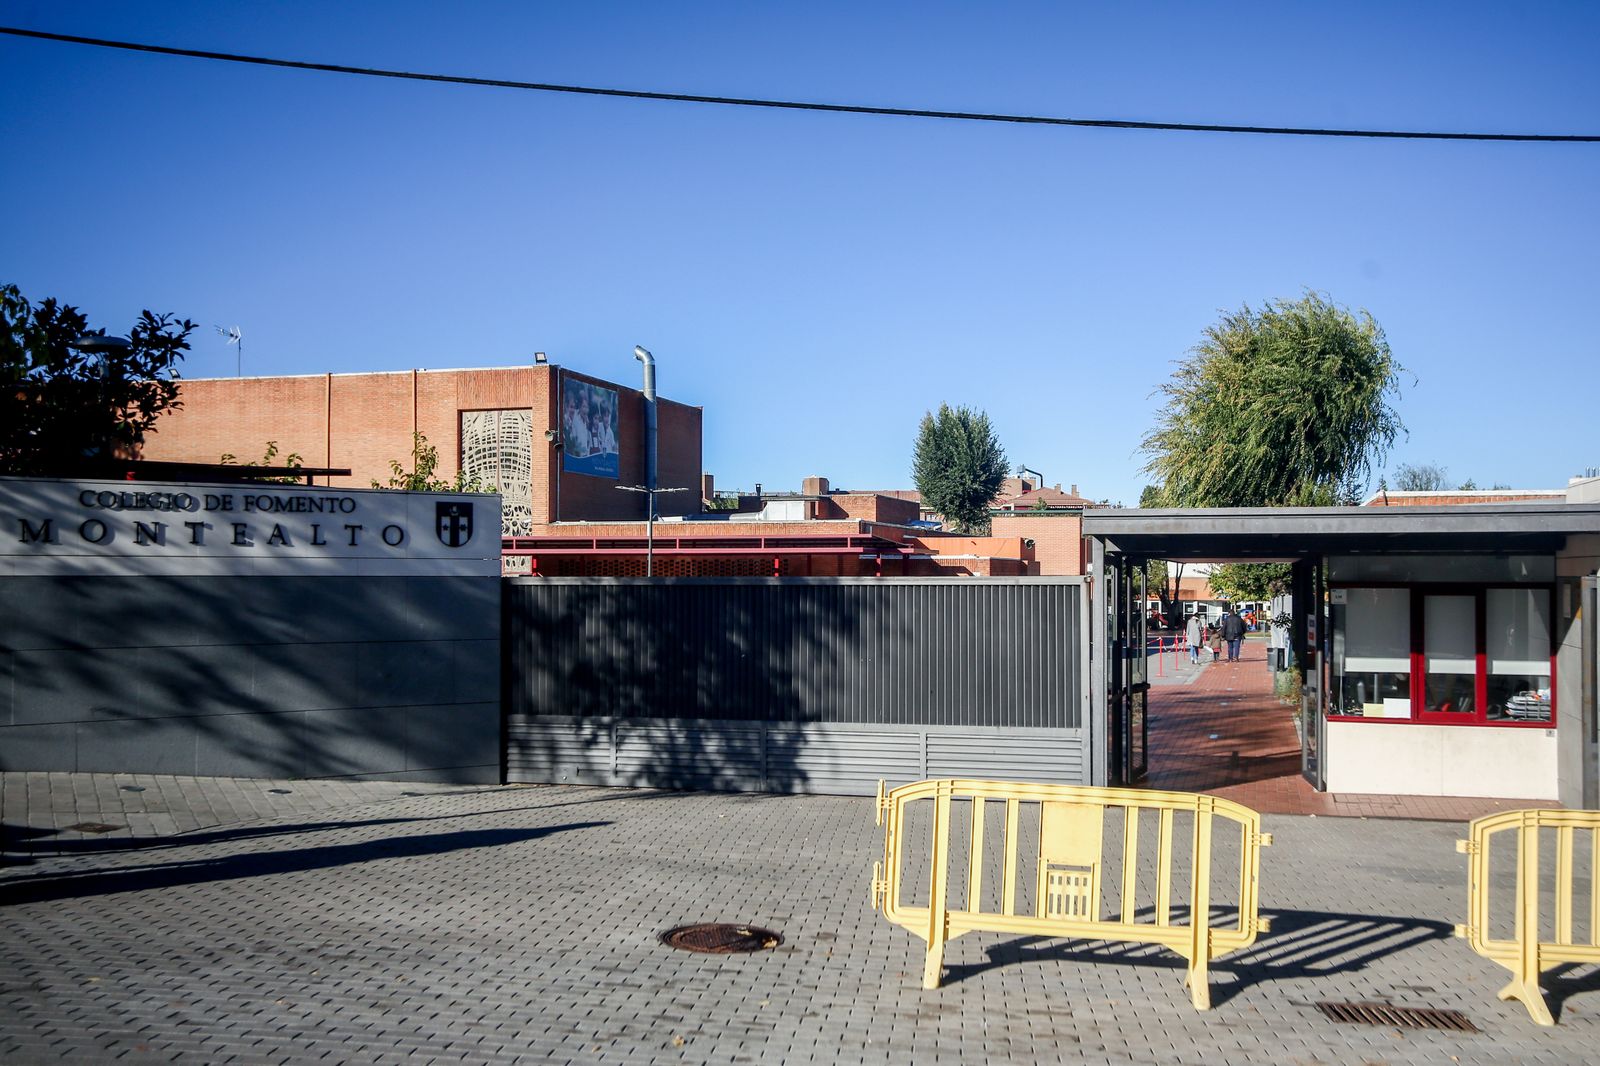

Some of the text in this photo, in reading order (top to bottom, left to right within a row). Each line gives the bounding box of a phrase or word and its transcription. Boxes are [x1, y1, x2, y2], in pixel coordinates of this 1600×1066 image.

[80, 490, 356, 514] COLEGIO DE FOMENTO
[19, 518, 405, 546] MONTEALTO
